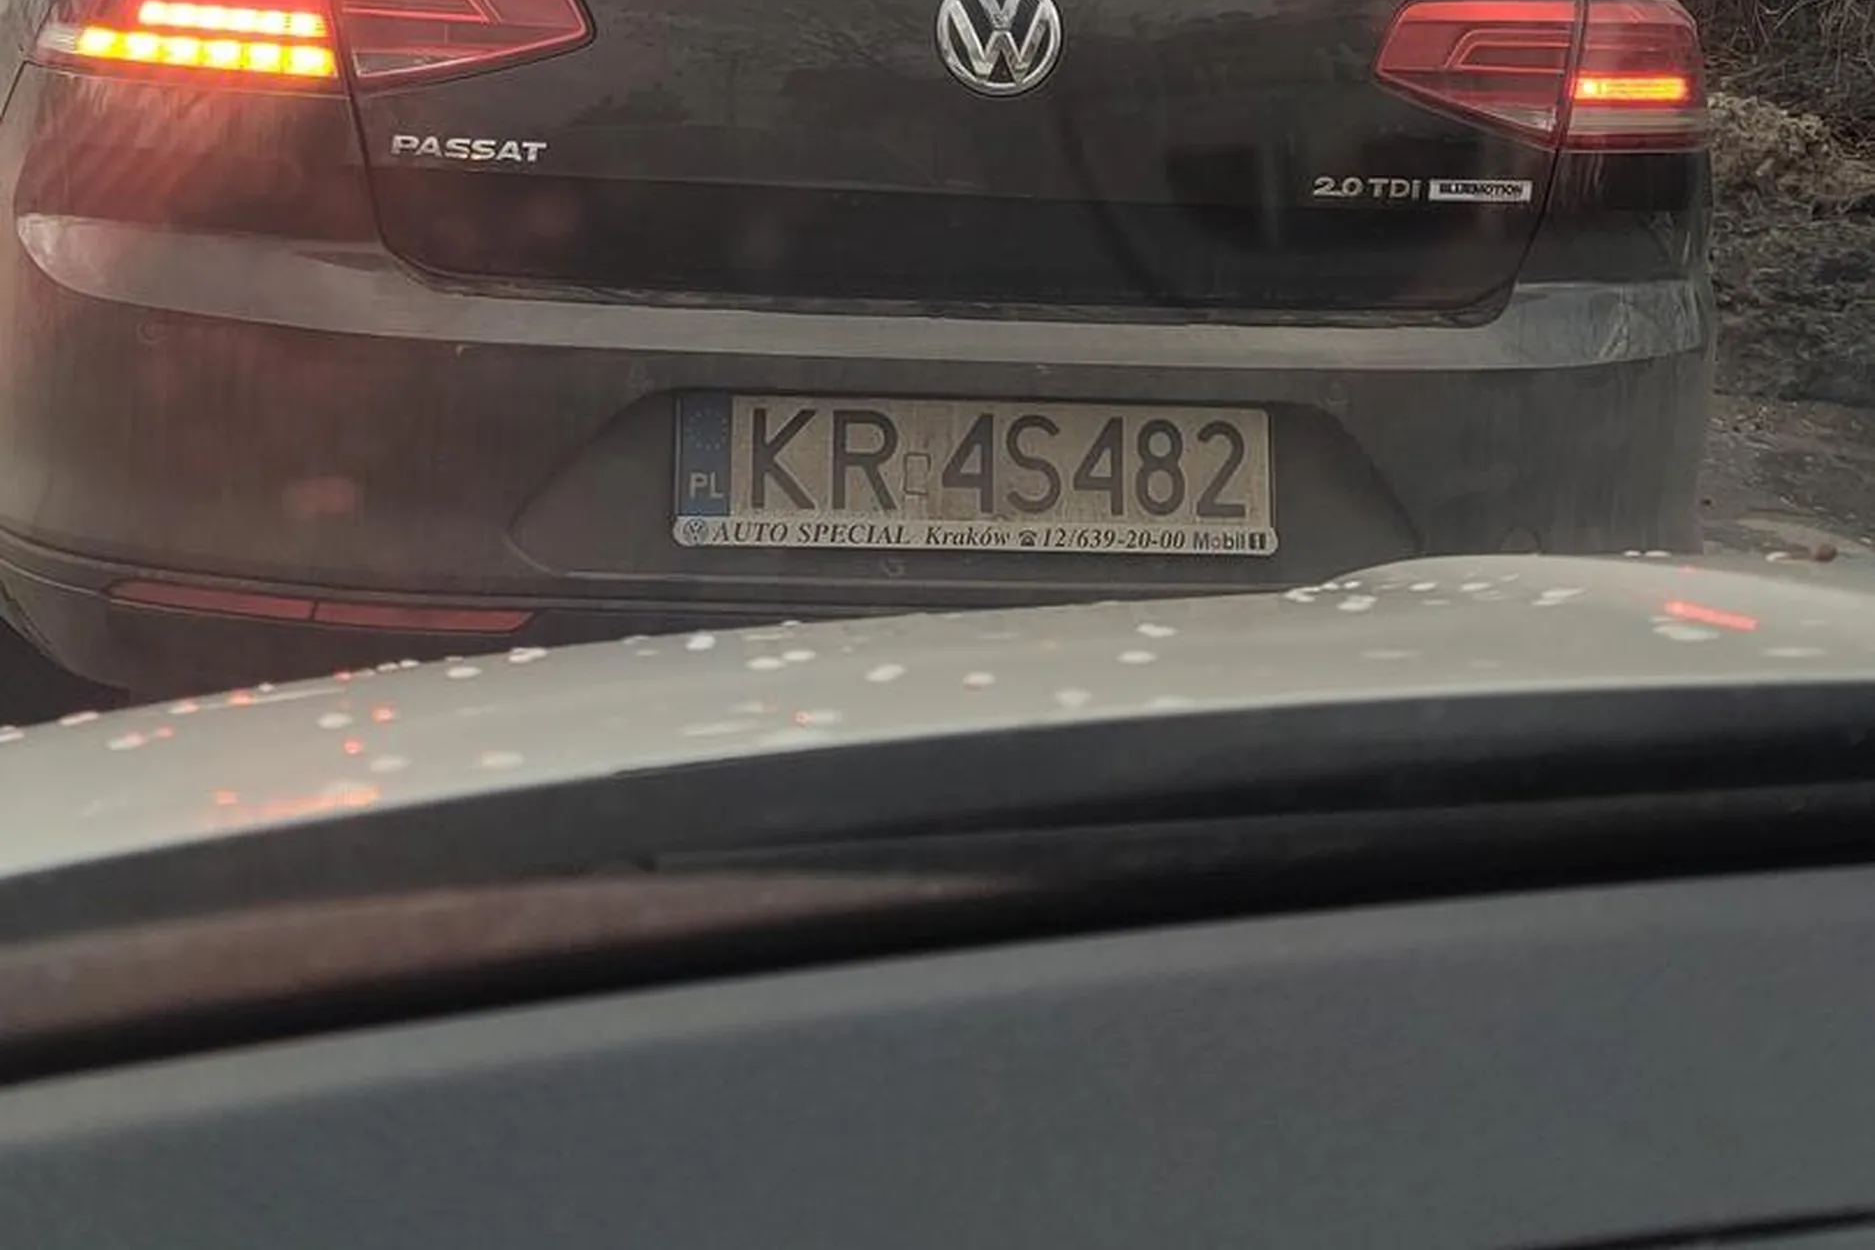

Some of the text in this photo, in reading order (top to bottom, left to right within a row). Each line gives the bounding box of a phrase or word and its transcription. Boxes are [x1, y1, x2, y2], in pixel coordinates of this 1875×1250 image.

[391, 135, 547, 162] PASSAT
[751, 408, 1247, 518] KR 4S482
[689, 472, 724, 499] PL
[712, 522, 788, 543] AUTO
[797, 523, 911, 545] SPECIAL
[925, 526, 1010, 549] Kraków
[1042, 528, 1186, 550] 12/639-20-00
